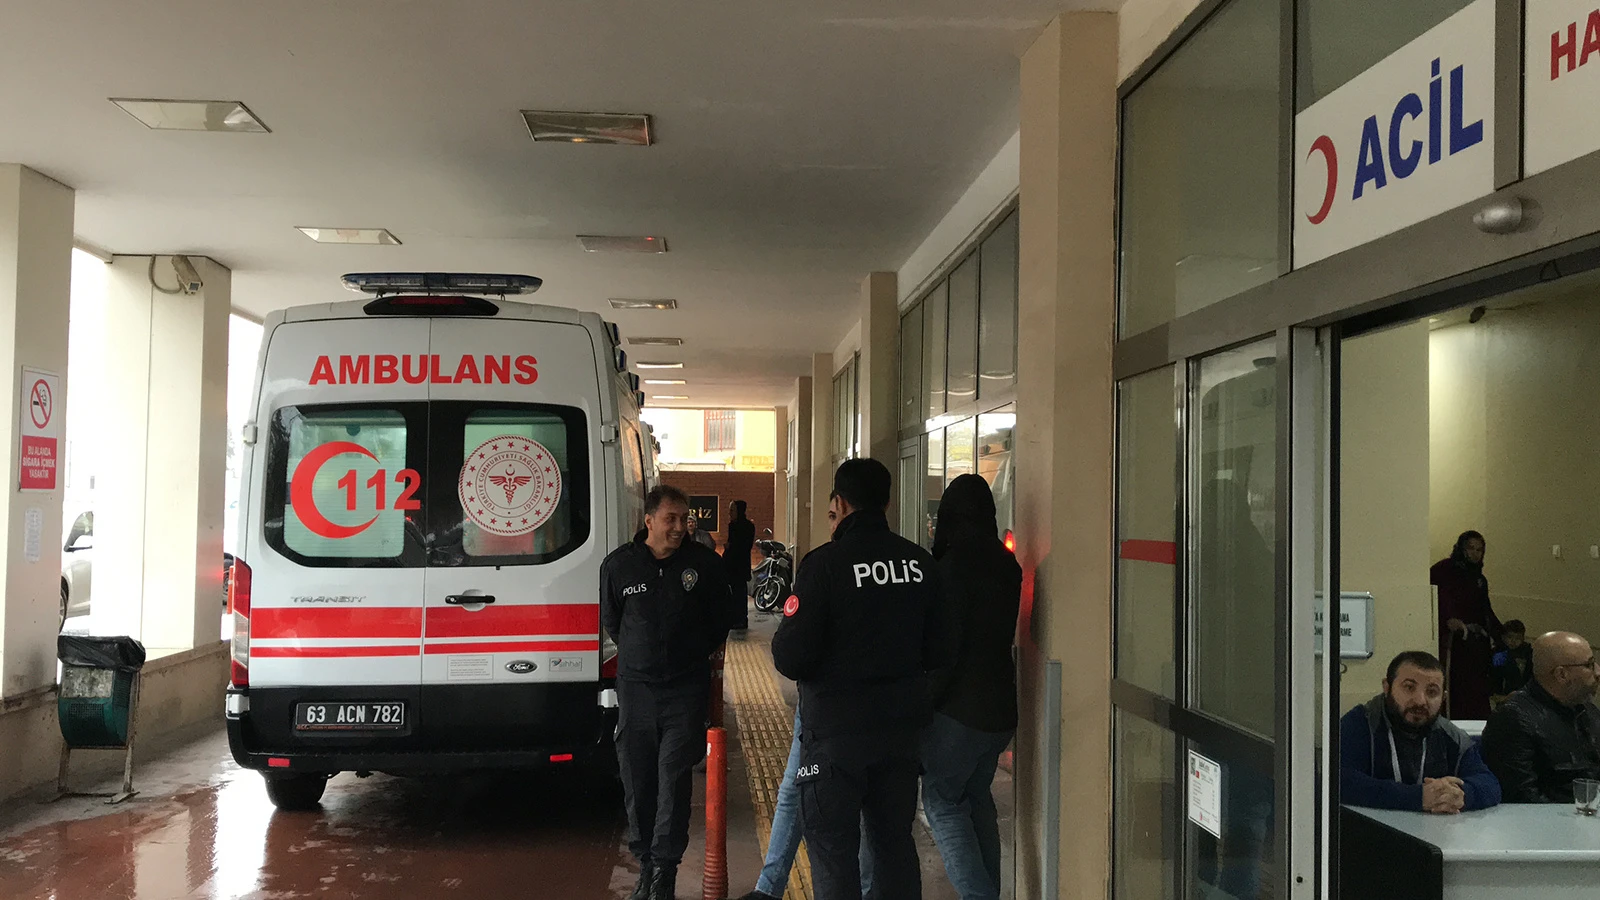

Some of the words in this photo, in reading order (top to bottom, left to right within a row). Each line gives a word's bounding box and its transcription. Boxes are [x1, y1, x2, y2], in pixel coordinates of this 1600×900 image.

[1352, 57, 1484, 200] ACİL
[308, 354, 539, 386] AMBULANS
[337, 468, 421, 511] 112
[306, 705, 326, 723] 63
[336, 705, 366, 723] ACN
[372, 705, 401, 723] 782
